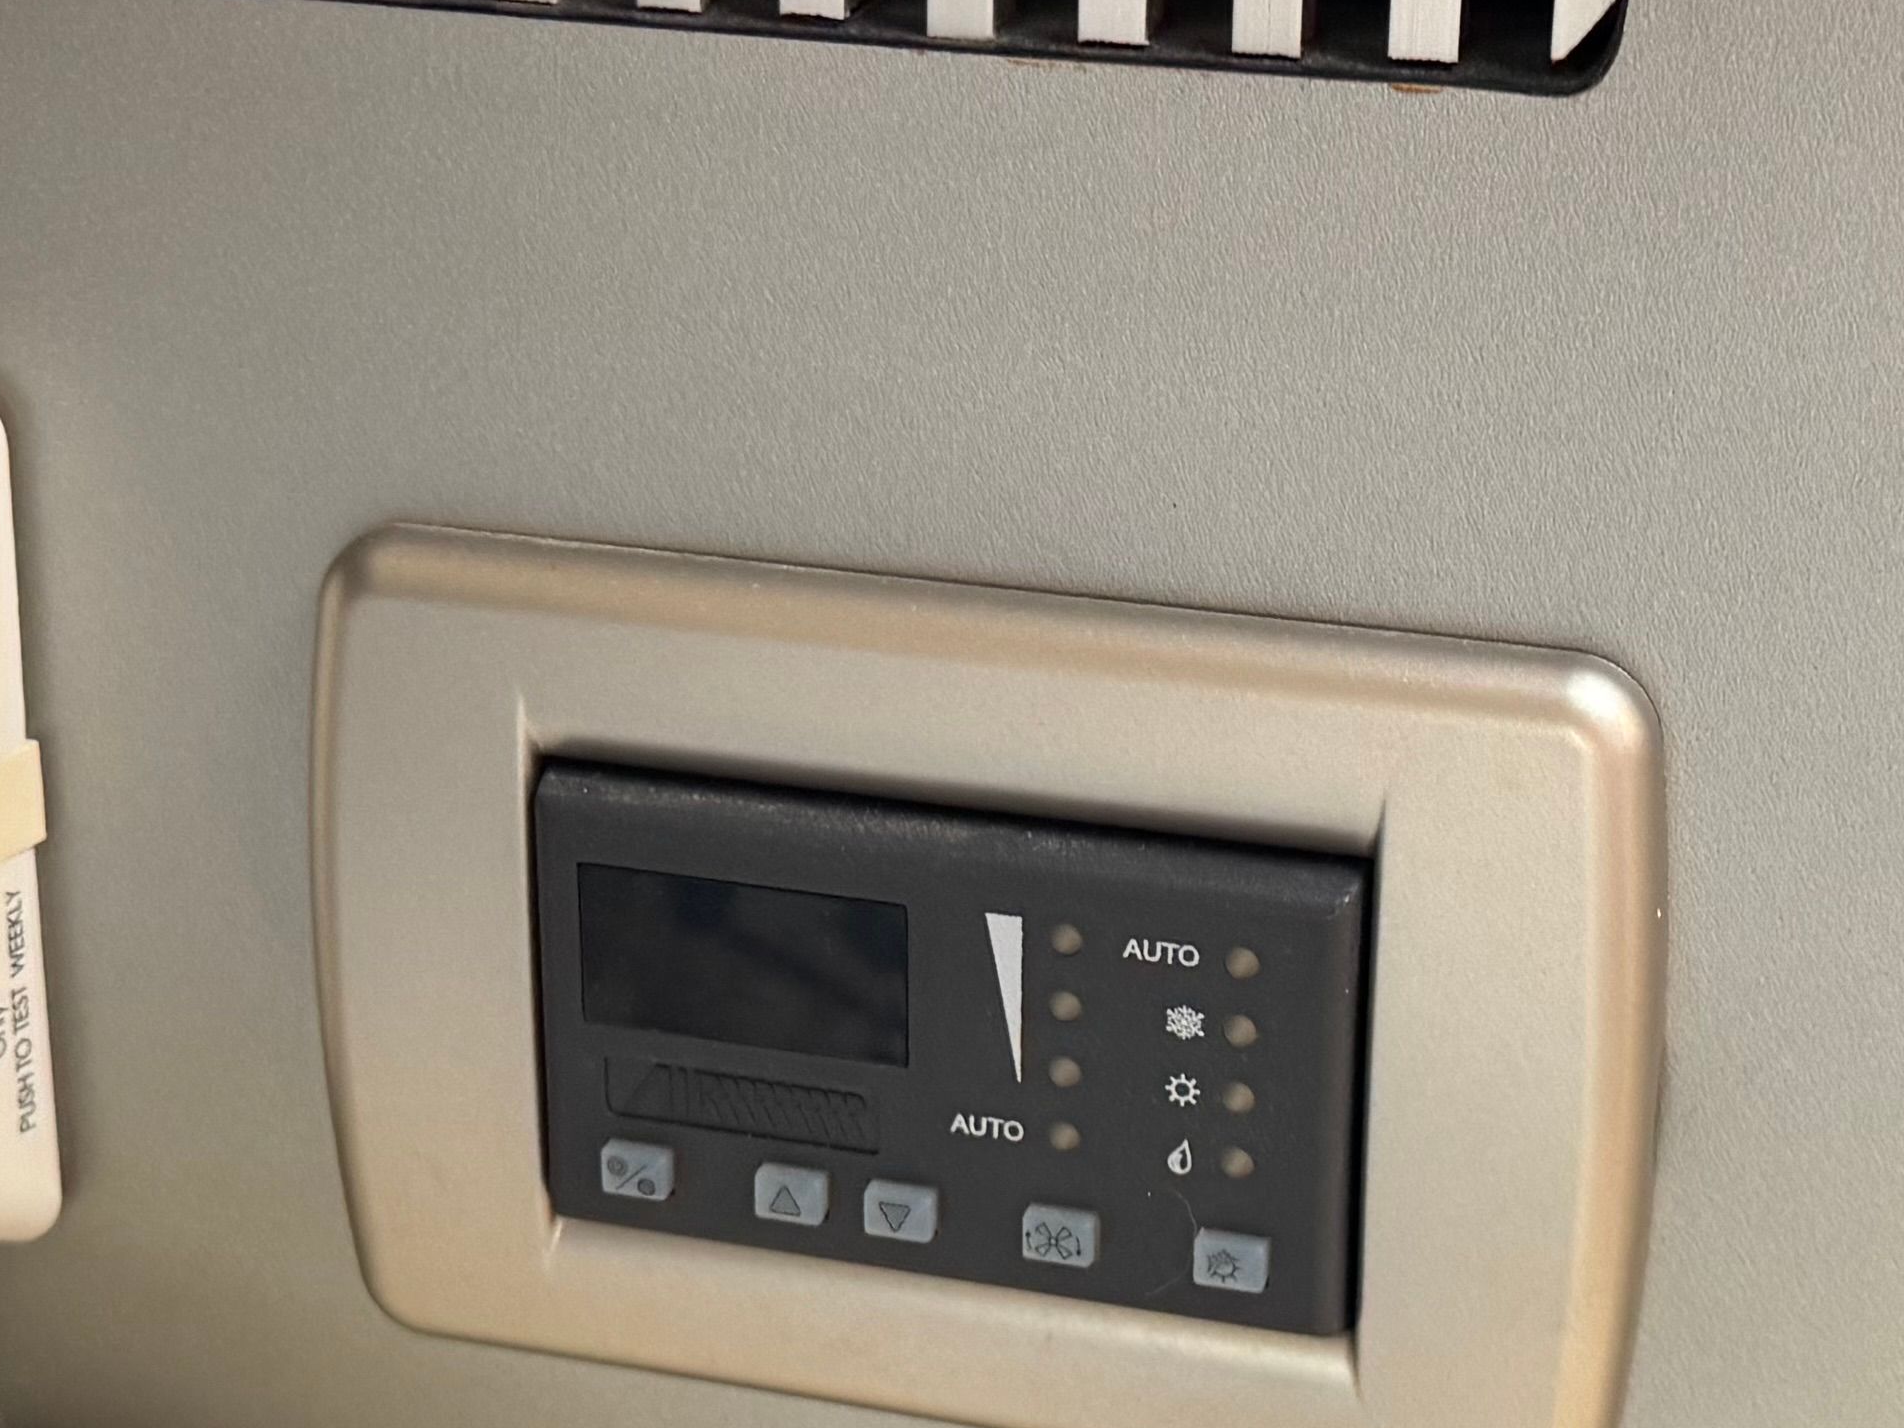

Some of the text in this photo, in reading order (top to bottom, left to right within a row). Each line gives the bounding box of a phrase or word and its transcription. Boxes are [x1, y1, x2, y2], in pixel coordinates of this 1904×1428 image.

[1122, 937, 1201, 969] AUTO
[5, 889, 37, 1134] PUSH TO TEST WEEKLY
[949, 1113, 1026, 1143] AUTO
